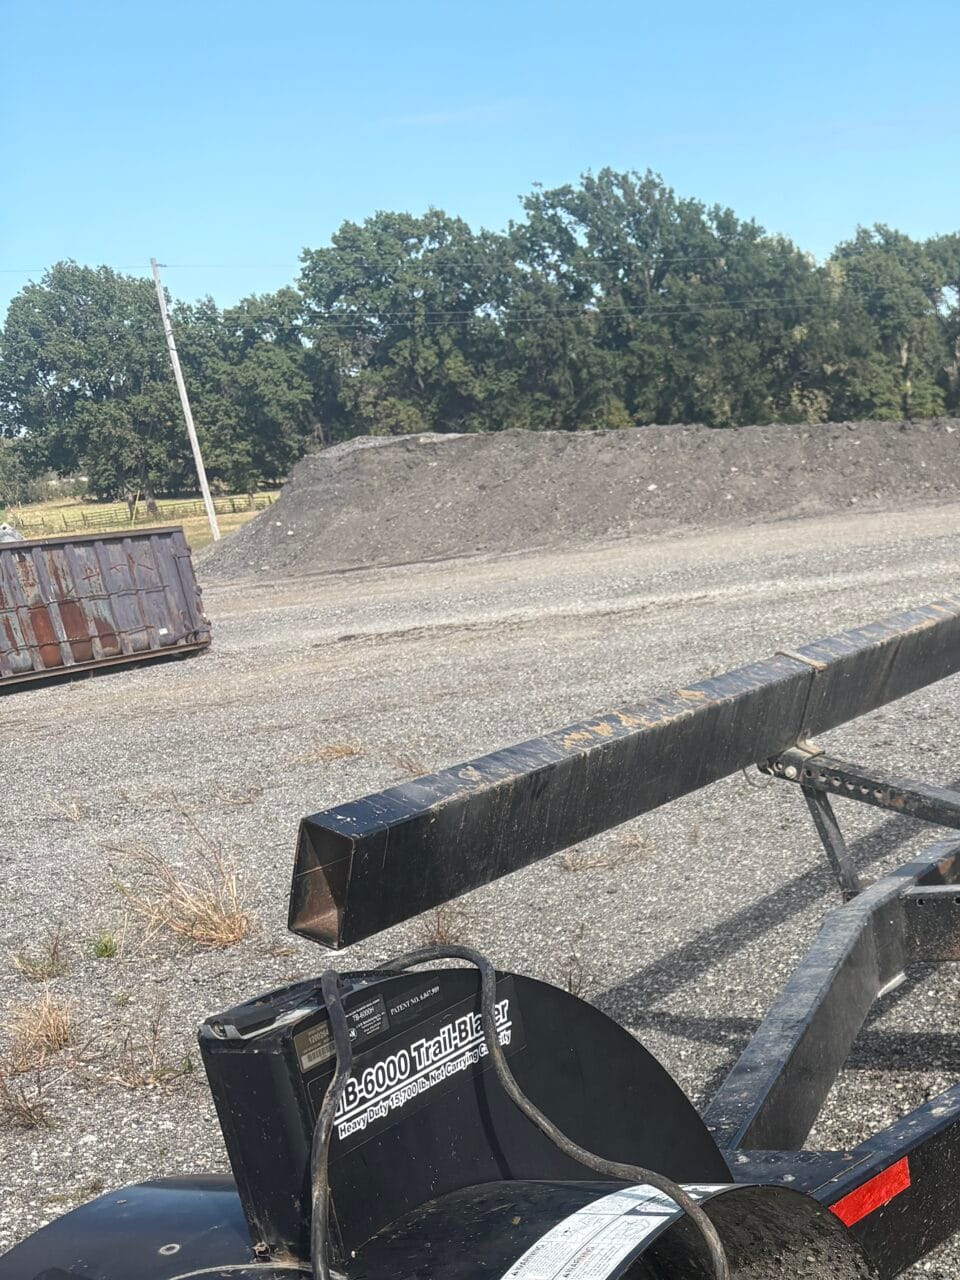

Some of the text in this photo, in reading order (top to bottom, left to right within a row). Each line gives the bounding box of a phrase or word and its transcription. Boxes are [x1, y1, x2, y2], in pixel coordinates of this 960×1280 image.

[390, 999, 410, 1016] PATENT
[410, 999, 509, 1071] Trail-Blaer
[337, 1112, 368, 1141] Heavy
[367, 1099, 390, 1123] Duty
[390, 1081, 418, 1110] 15,700
[417, 1076, 431, 1093] lb.
[429, 1065, 447, 1087] Net
[445, 1047, 479, 1077] Carrying
